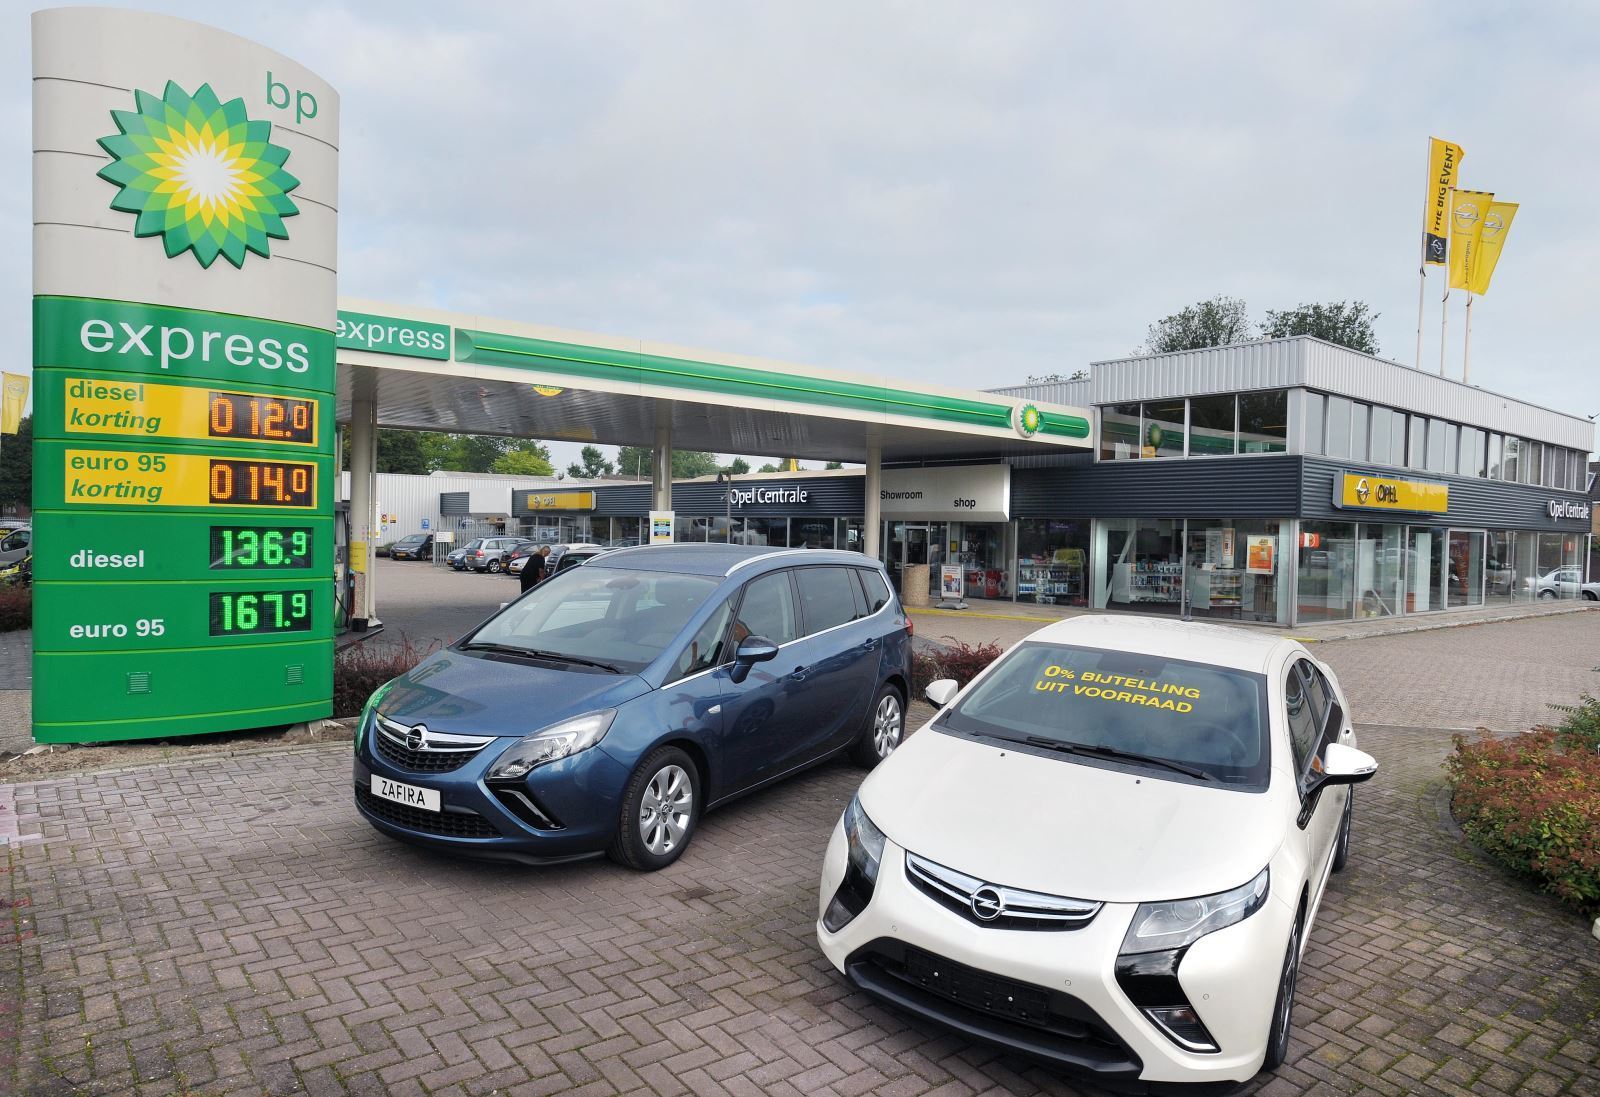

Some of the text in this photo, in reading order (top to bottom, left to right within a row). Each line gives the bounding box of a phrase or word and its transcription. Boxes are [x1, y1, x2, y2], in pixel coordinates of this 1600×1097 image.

[266, 71, 318, 124] bp
[1434, 145, 1454, 232] THE BIG EVENT
[80, 318, 309, 373] express
[69, 381, 144, 402] diesel
[70, 408, 161, 433] korting
[71, 455, 167, 472] euro 95
[71, 480, 162, 503] korting
[730, 486, 807, 508] Opel Centrale
[880, 490, 976, 509] Showroom shop
[1376, 484, 1398, 503] OPEL
[1550, 500, 1589, 522] Opel Centrale
[70, 550, 145, 568] diesel
[222, 530, 307, 565] 136.9
[222, 593, 306, 630] 167.9
[70, 619, 165, 638] euro 95
[1044, 665, 1200, 699] 0% BIJTELLING
[1035, 681, 1193, 713] UIT VOORRAAD
[381, 780, 426, 806] ZAFIRA
